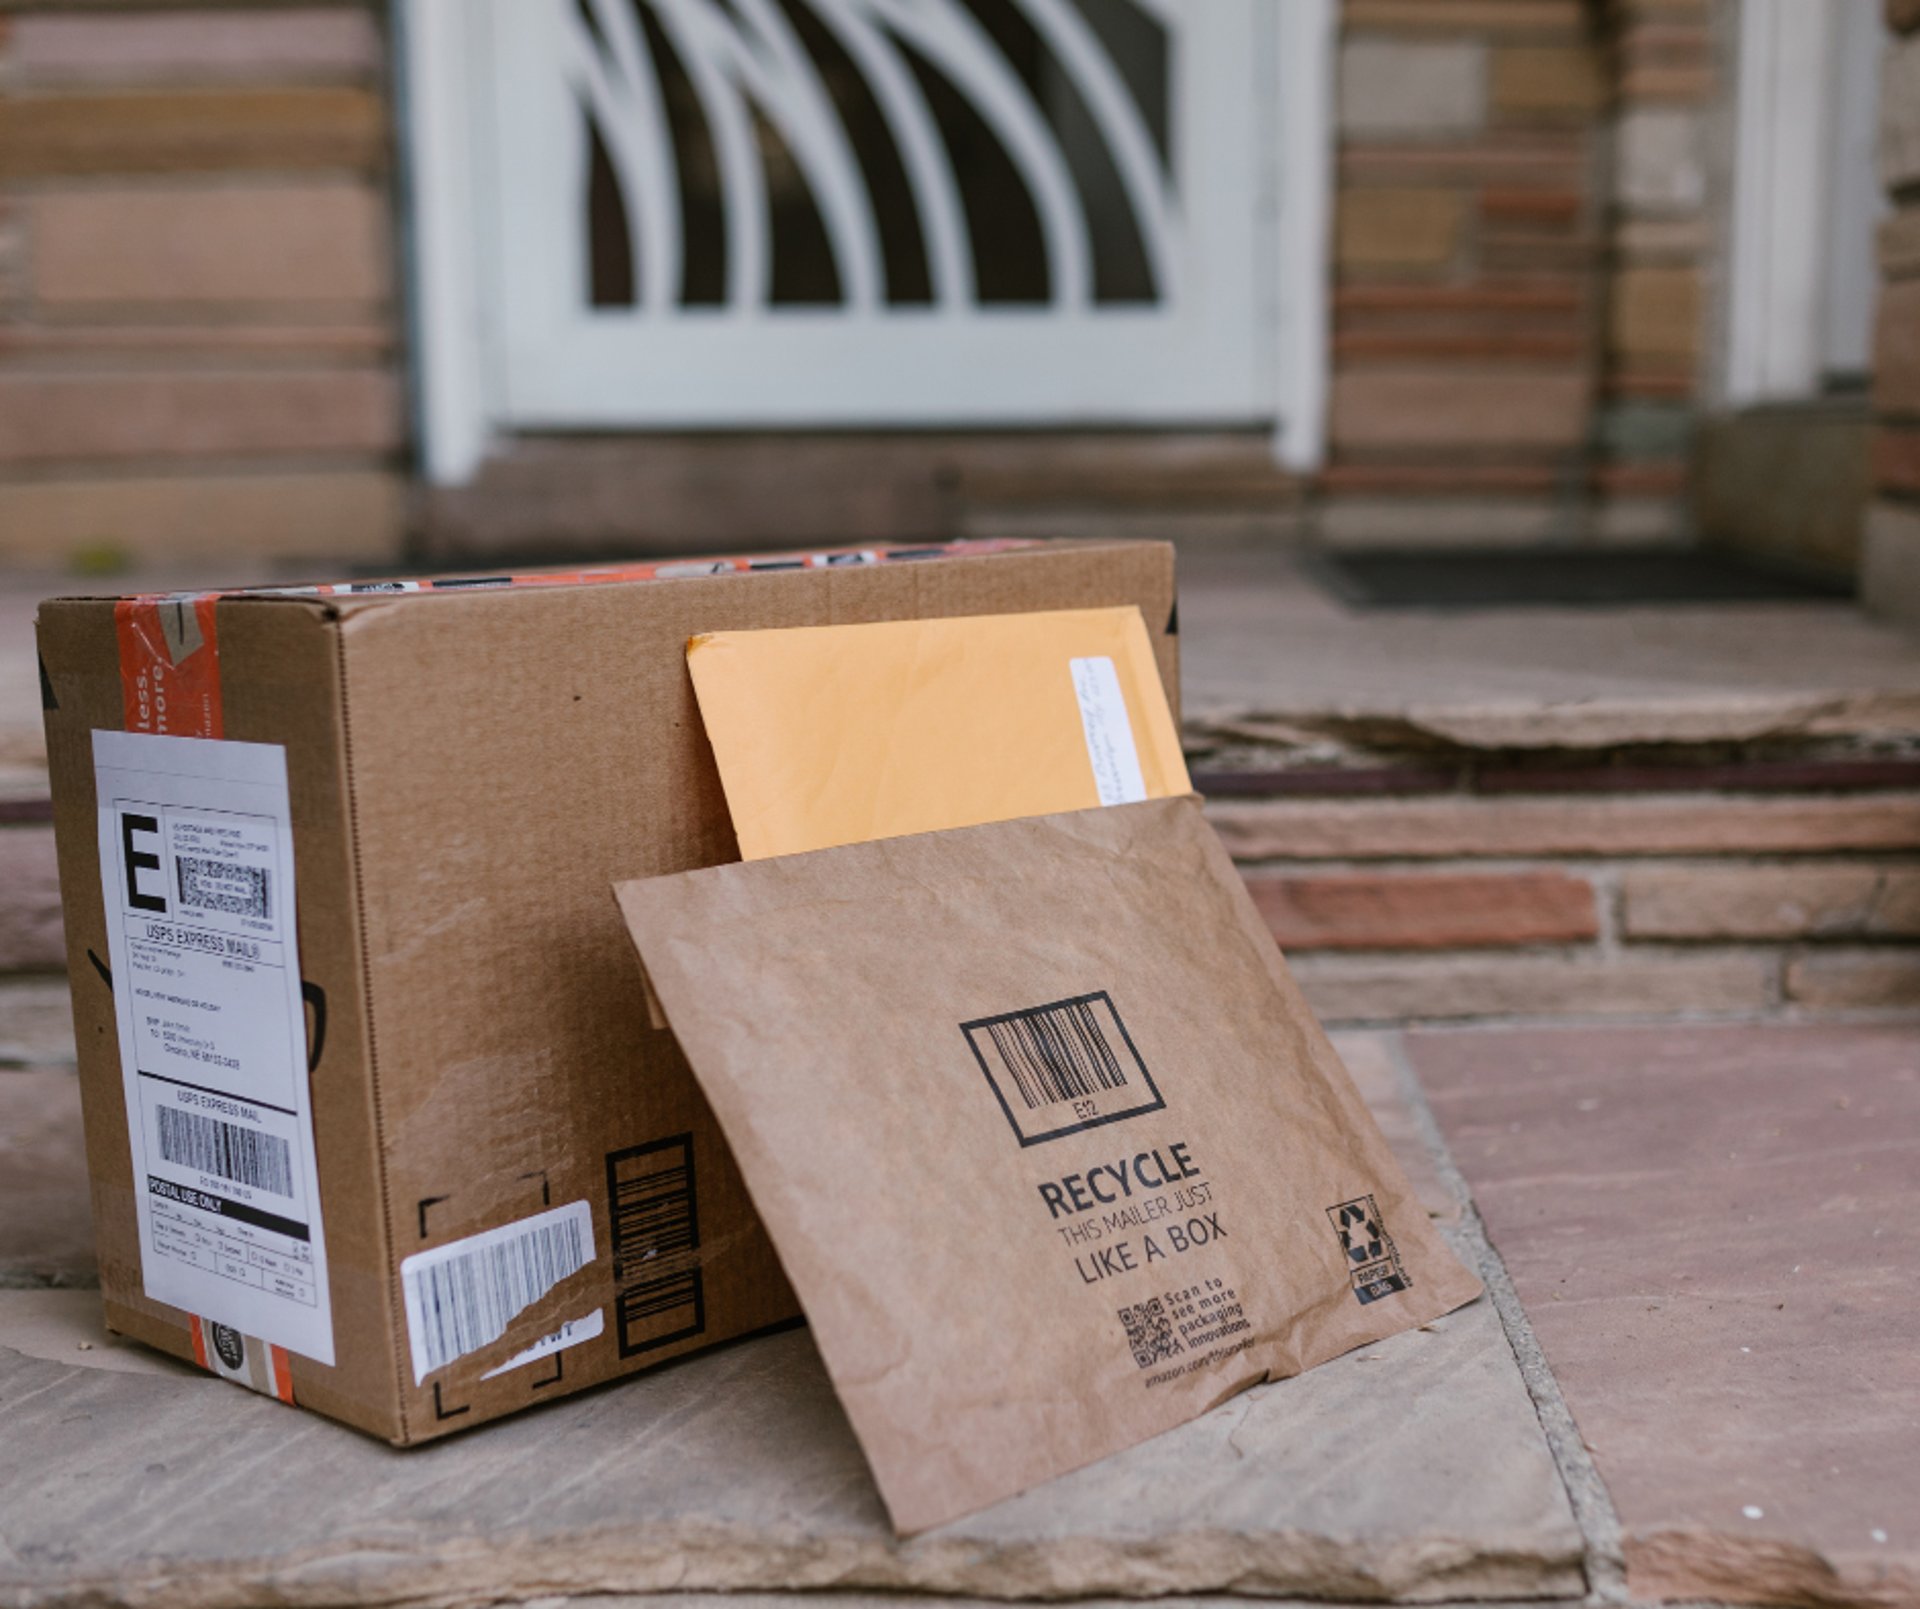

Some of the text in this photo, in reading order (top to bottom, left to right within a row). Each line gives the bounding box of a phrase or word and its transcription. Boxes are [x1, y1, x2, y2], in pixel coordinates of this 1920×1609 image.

[136, 667, 150, 730] less.
[121, 812, 167, 913] E
[146, 924, 174, 942] USPS
[177, 928, 225, 953] EXPRESS
[177, 1090, 199, 1106] USPS
[201, 1096, 239, 1118] EXPRESS
[1072, 1100, 1100, 1120] E12
[150, 1178, 181, 1200] POSTAL
[181, 1189, 199, 1206] USE
[200, 1193, 221, 1212] ONLY
[1037, 1142, 1200, 1220] RECYCLE
[1058, 1182, 1215, 1248] THIS MAILER JUST
[1075, 1211, 1229, 1285] LIKE A BOX
[1164, 1277, 1223, 1306] Scan to
[1172, 1288, 1237, 1320] see more
[1178, 1302, 1244, 1339] packaging
